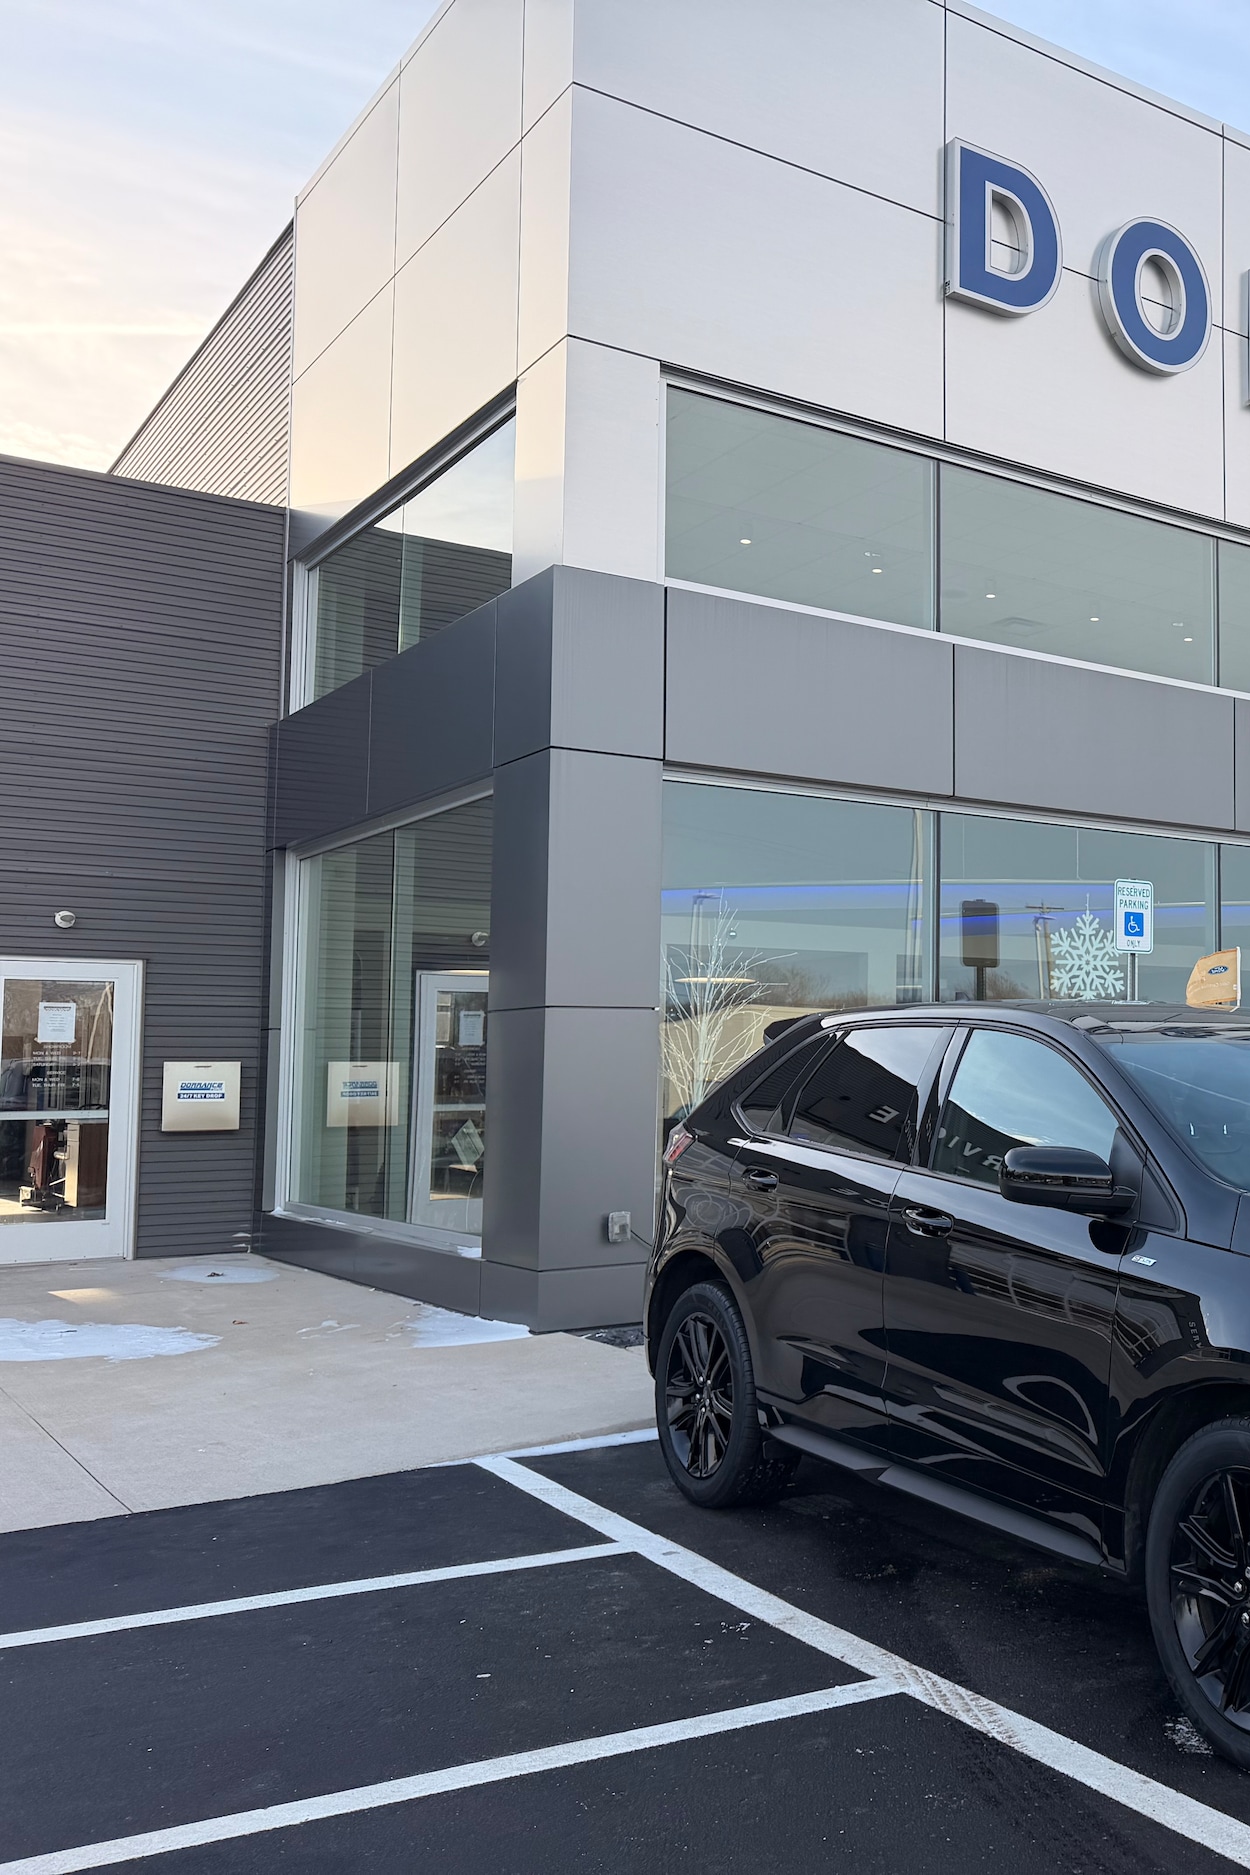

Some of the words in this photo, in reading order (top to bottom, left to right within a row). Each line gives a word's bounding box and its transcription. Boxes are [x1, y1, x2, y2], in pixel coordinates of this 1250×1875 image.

[1118, 886, 1150, 898] RESERVED
[1119, 899, 1149, 910] PARKING
[1127, 939, 1140, 948] ONLY
